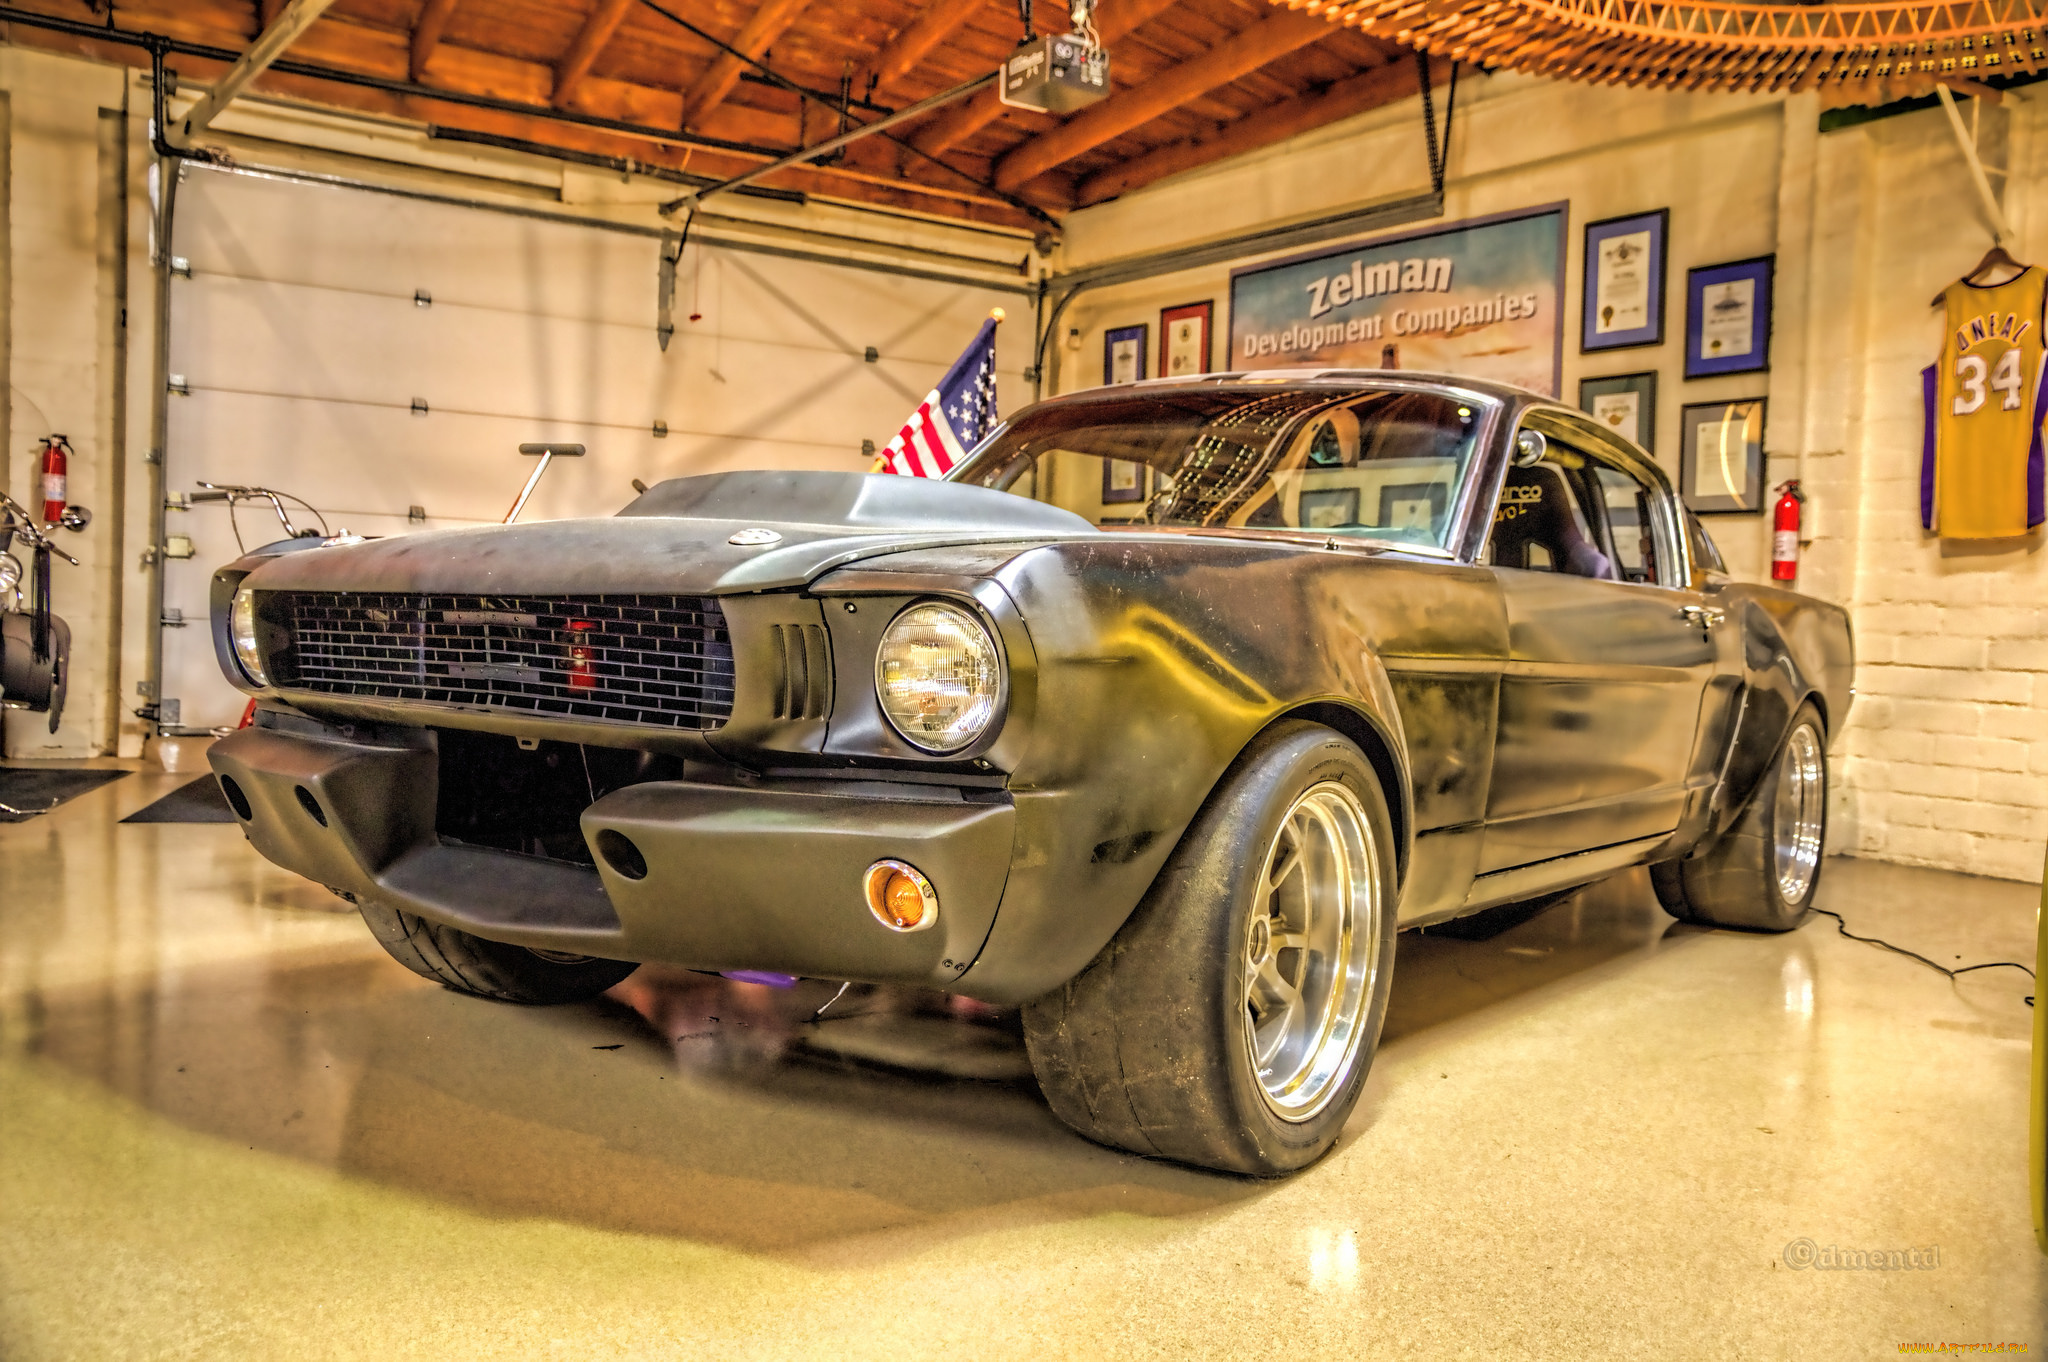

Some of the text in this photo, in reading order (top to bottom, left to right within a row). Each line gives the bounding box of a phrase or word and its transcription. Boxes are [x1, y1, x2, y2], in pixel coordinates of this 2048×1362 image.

[1244, 293, 1538, 359] Development Companies
[1952, 347, 2023, 416] 34
